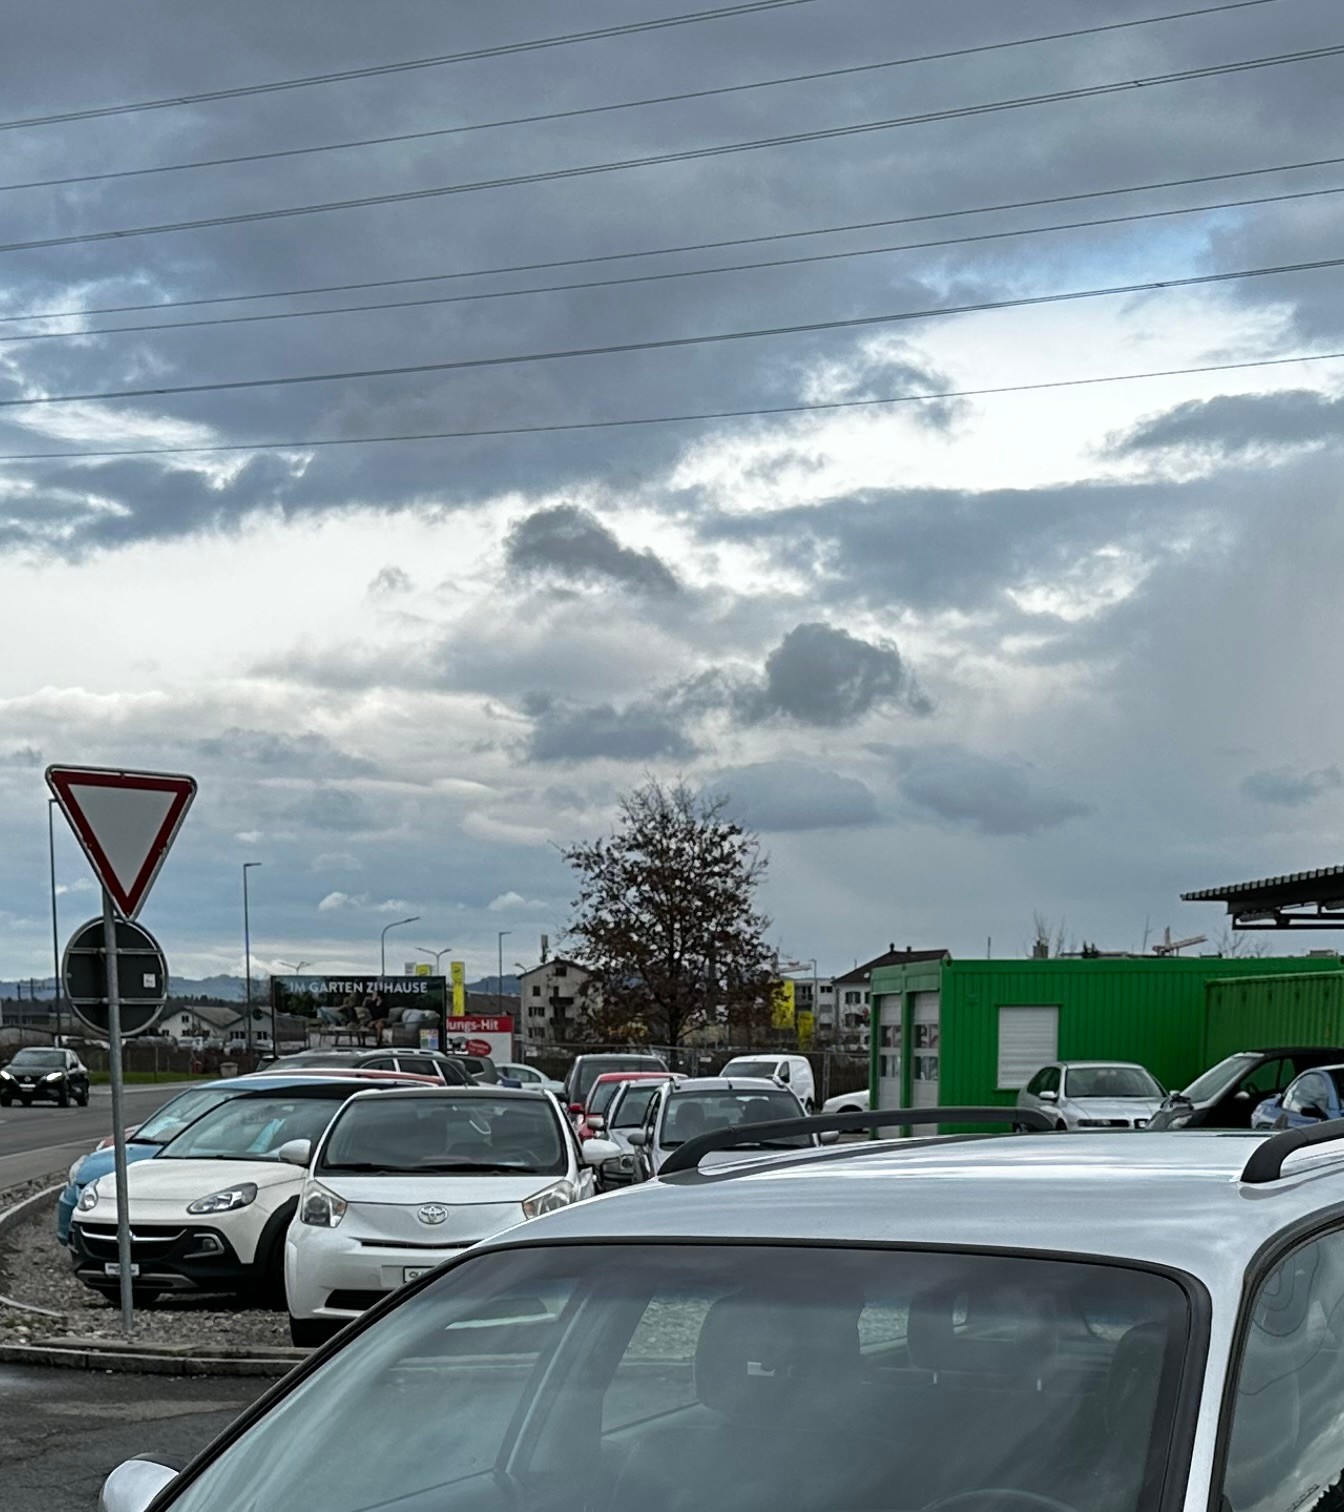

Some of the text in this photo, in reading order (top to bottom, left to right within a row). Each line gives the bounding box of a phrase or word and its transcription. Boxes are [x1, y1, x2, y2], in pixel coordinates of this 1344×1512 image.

[290, 981, 428, 994] IM GARTEN ZUHAUSE
